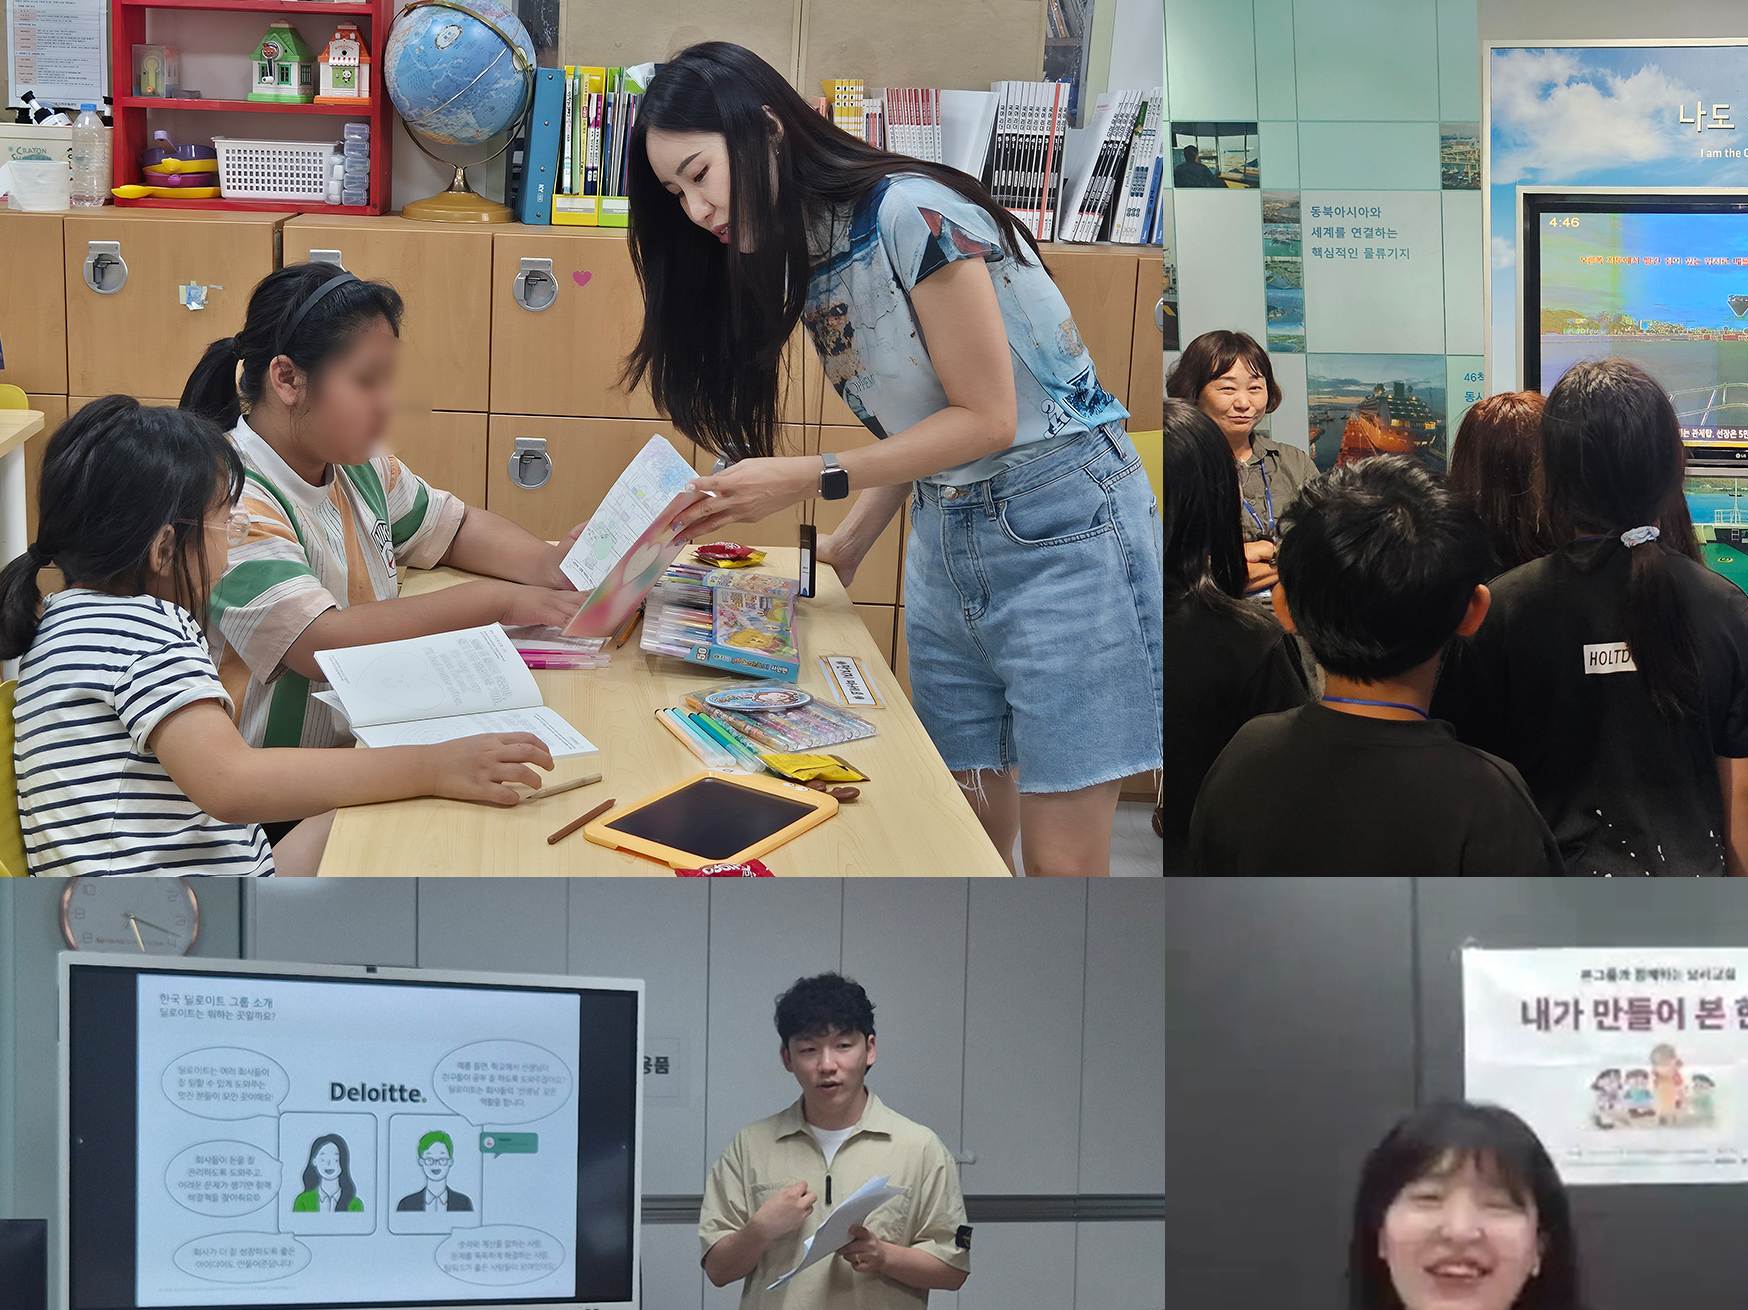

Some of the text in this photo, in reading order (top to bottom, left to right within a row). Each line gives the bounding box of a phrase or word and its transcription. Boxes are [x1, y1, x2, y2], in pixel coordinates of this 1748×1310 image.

[1679, 100, 1735, 133] 나도
[1700, 148, 1704, 158] I
[1706, 149, 1722, 158] am
[1725, 148, 1741, 158] the
[1310, 206, 1382, 219] 동북아시아와
[1549, 217, 1580, 228] 4:46
[1311, 226, 1398, 239] 세계를 연결하는
[1312, 247, 1410, 260] 핵심적인 물류기지
[1717, 429, 1738, 439] 선장은
[160, 993, 273, 1009] 한국 딜로이트 그룹 소개
[160, 1008, 204, 1019] 딜로이트는
[1520, 997, 1585, 1032] 내가
[1593, 997, 1686, 1031] 만들어
[1695, 998, 1727, 1031] 본
[330, 1081, 427, 1103] Deloitte.
